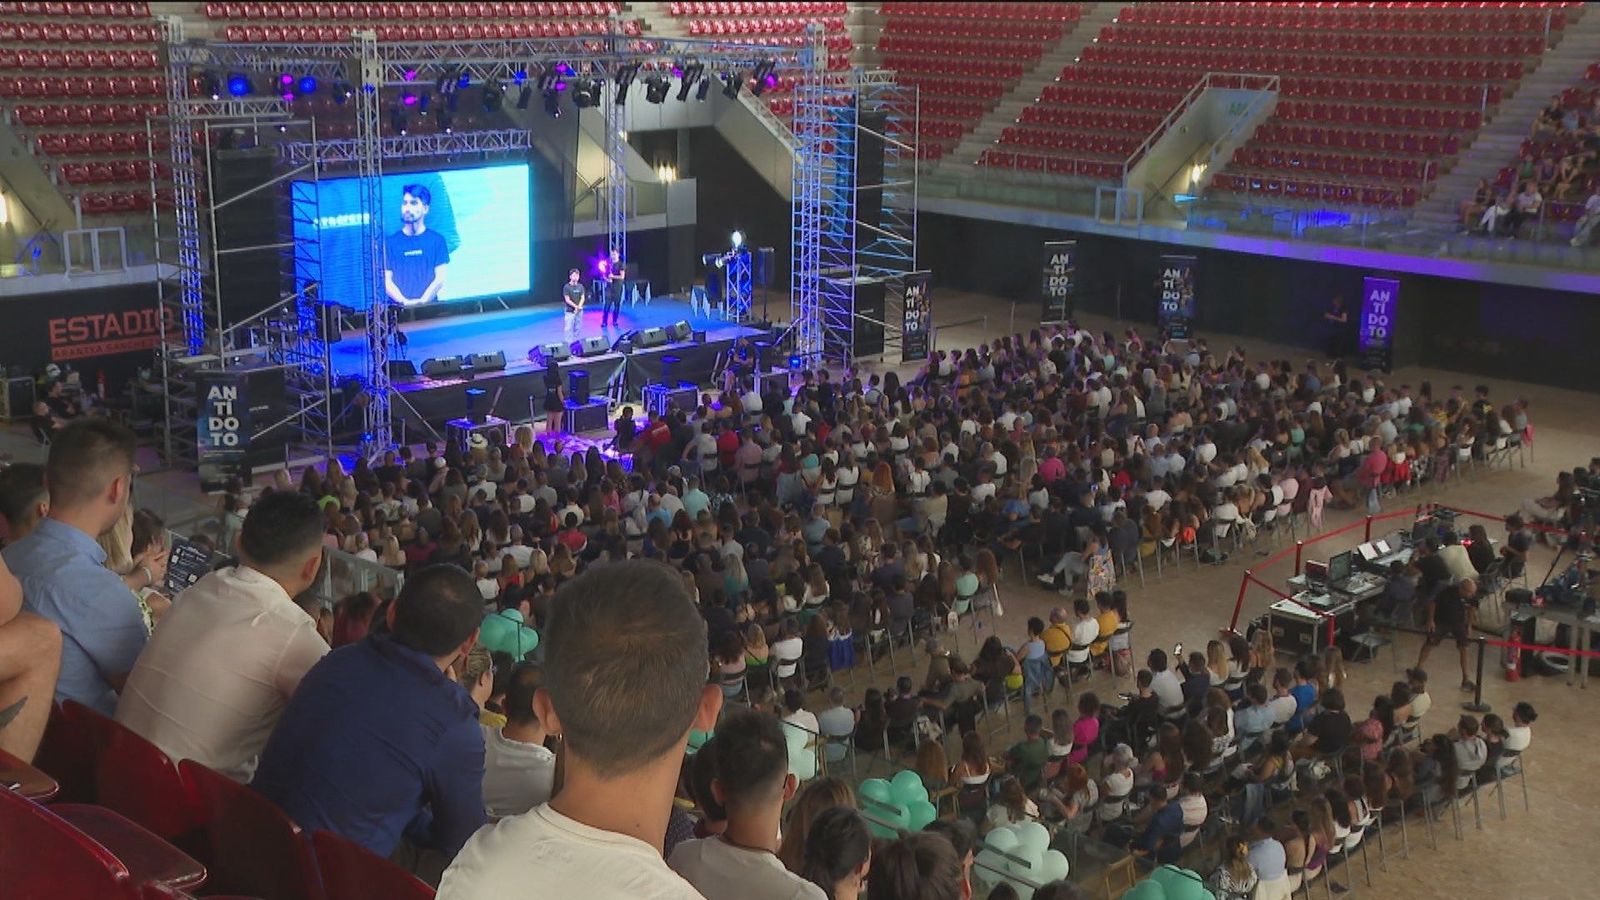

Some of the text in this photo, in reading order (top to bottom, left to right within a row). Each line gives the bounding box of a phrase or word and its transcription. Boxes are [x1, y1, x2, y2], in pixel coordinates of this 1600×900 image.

[1051, 254, 1069, 265] AN
[1163, 268, 1181, 278] AN
[1050, 276, 1068, 286] DO
[906, 286, 920, 297] AN
[1050, 286, 1067, 297] TO
[1163, 291, 1180, 300] DO
[1370, 289, 1390, 302] AN
[1162, 301, 1178, 311] TO
[905, 310, 920, 320] DO
[1368, 313, 1388, 326] DO
[48, 307, 174, 345] ESTADIO
[905, 321, 918, 332] TO
[1368, 326, 1387, 338] TO
[207, 386, 238, 400] AN
[208, 416, 240, 432] DO
[210, 432, 239, 447] TO
